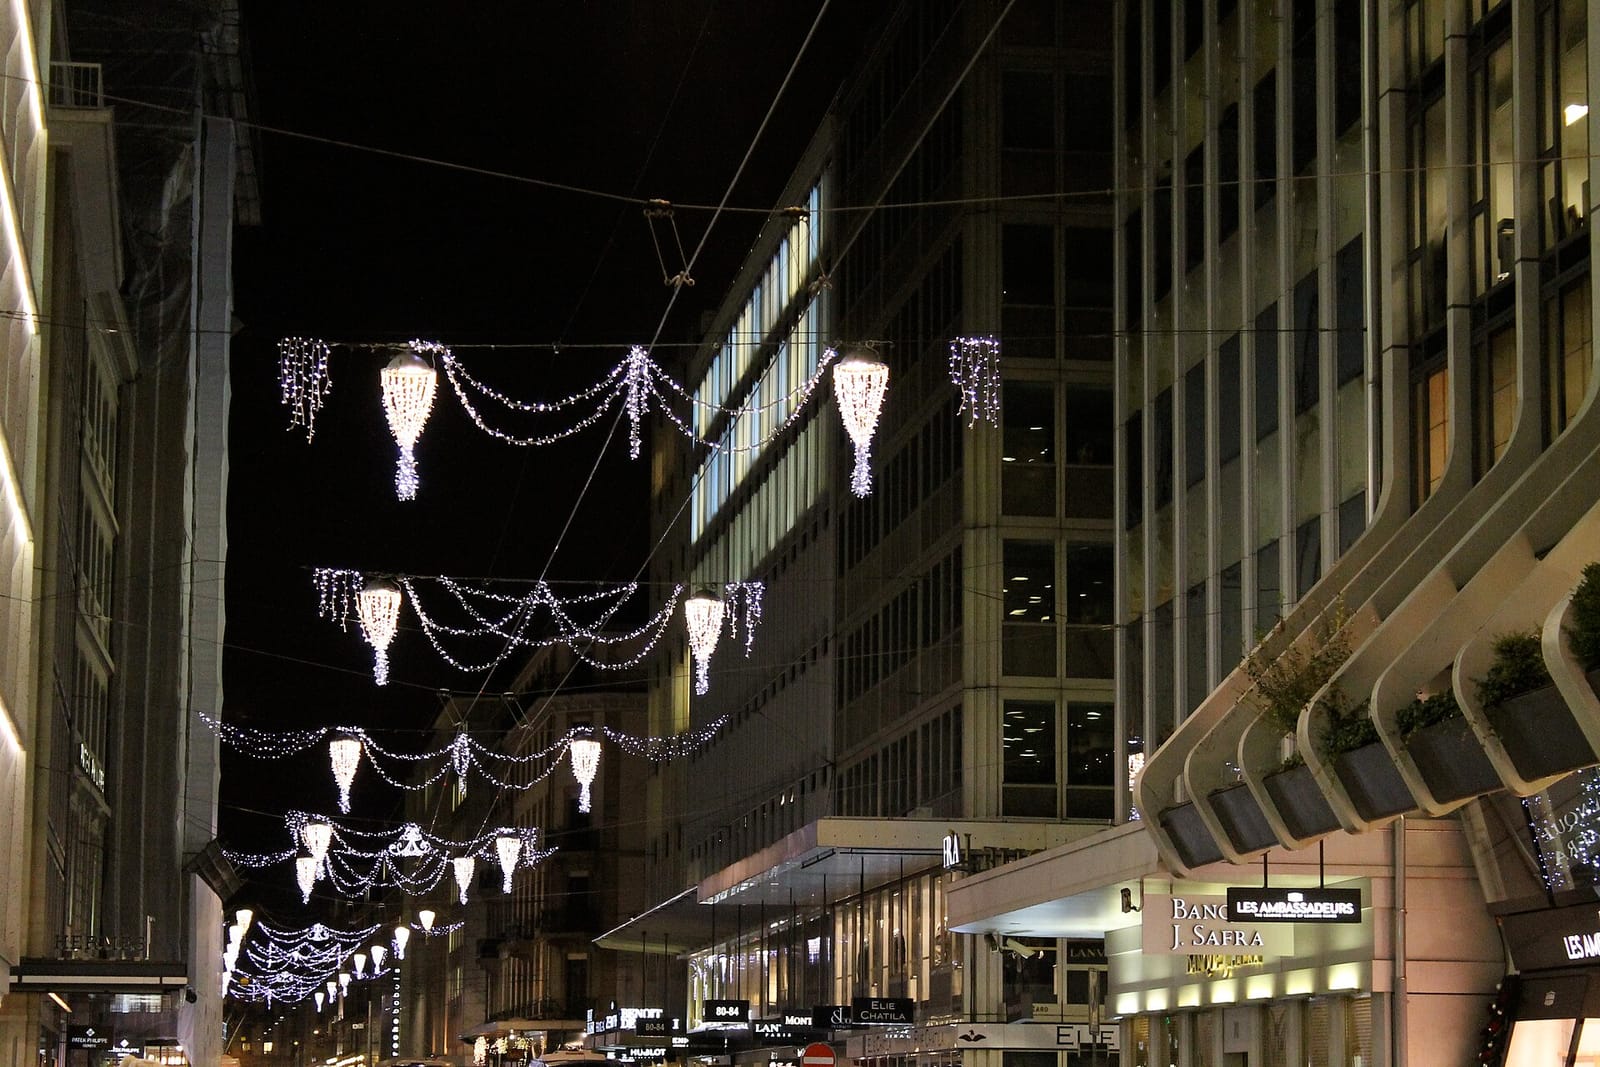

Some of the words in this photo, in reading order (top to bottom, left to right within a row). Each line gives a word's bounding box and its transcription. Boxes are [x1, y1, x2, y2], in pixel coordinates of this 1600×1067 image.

[1236, 901, 1260, 914] LES
[1259, 902, 1355, 916] AMBASSADEURS
[1170, 925, 1185, 951] J.
[1191, 924, 1265, 947] SAFRA
[1563, 934, 1585, 961] LES
[871, 1000, 896, 1010] ELIE
[620, 1008, 663, 1019] BENOIT
[715, 1006, 740, 1017] 80-84
[860, 1010, 906, 1021] CHATILA
[755, 1023, 782, 1033] LAN
[630, 1048, 666, 1056] HUBLOT
